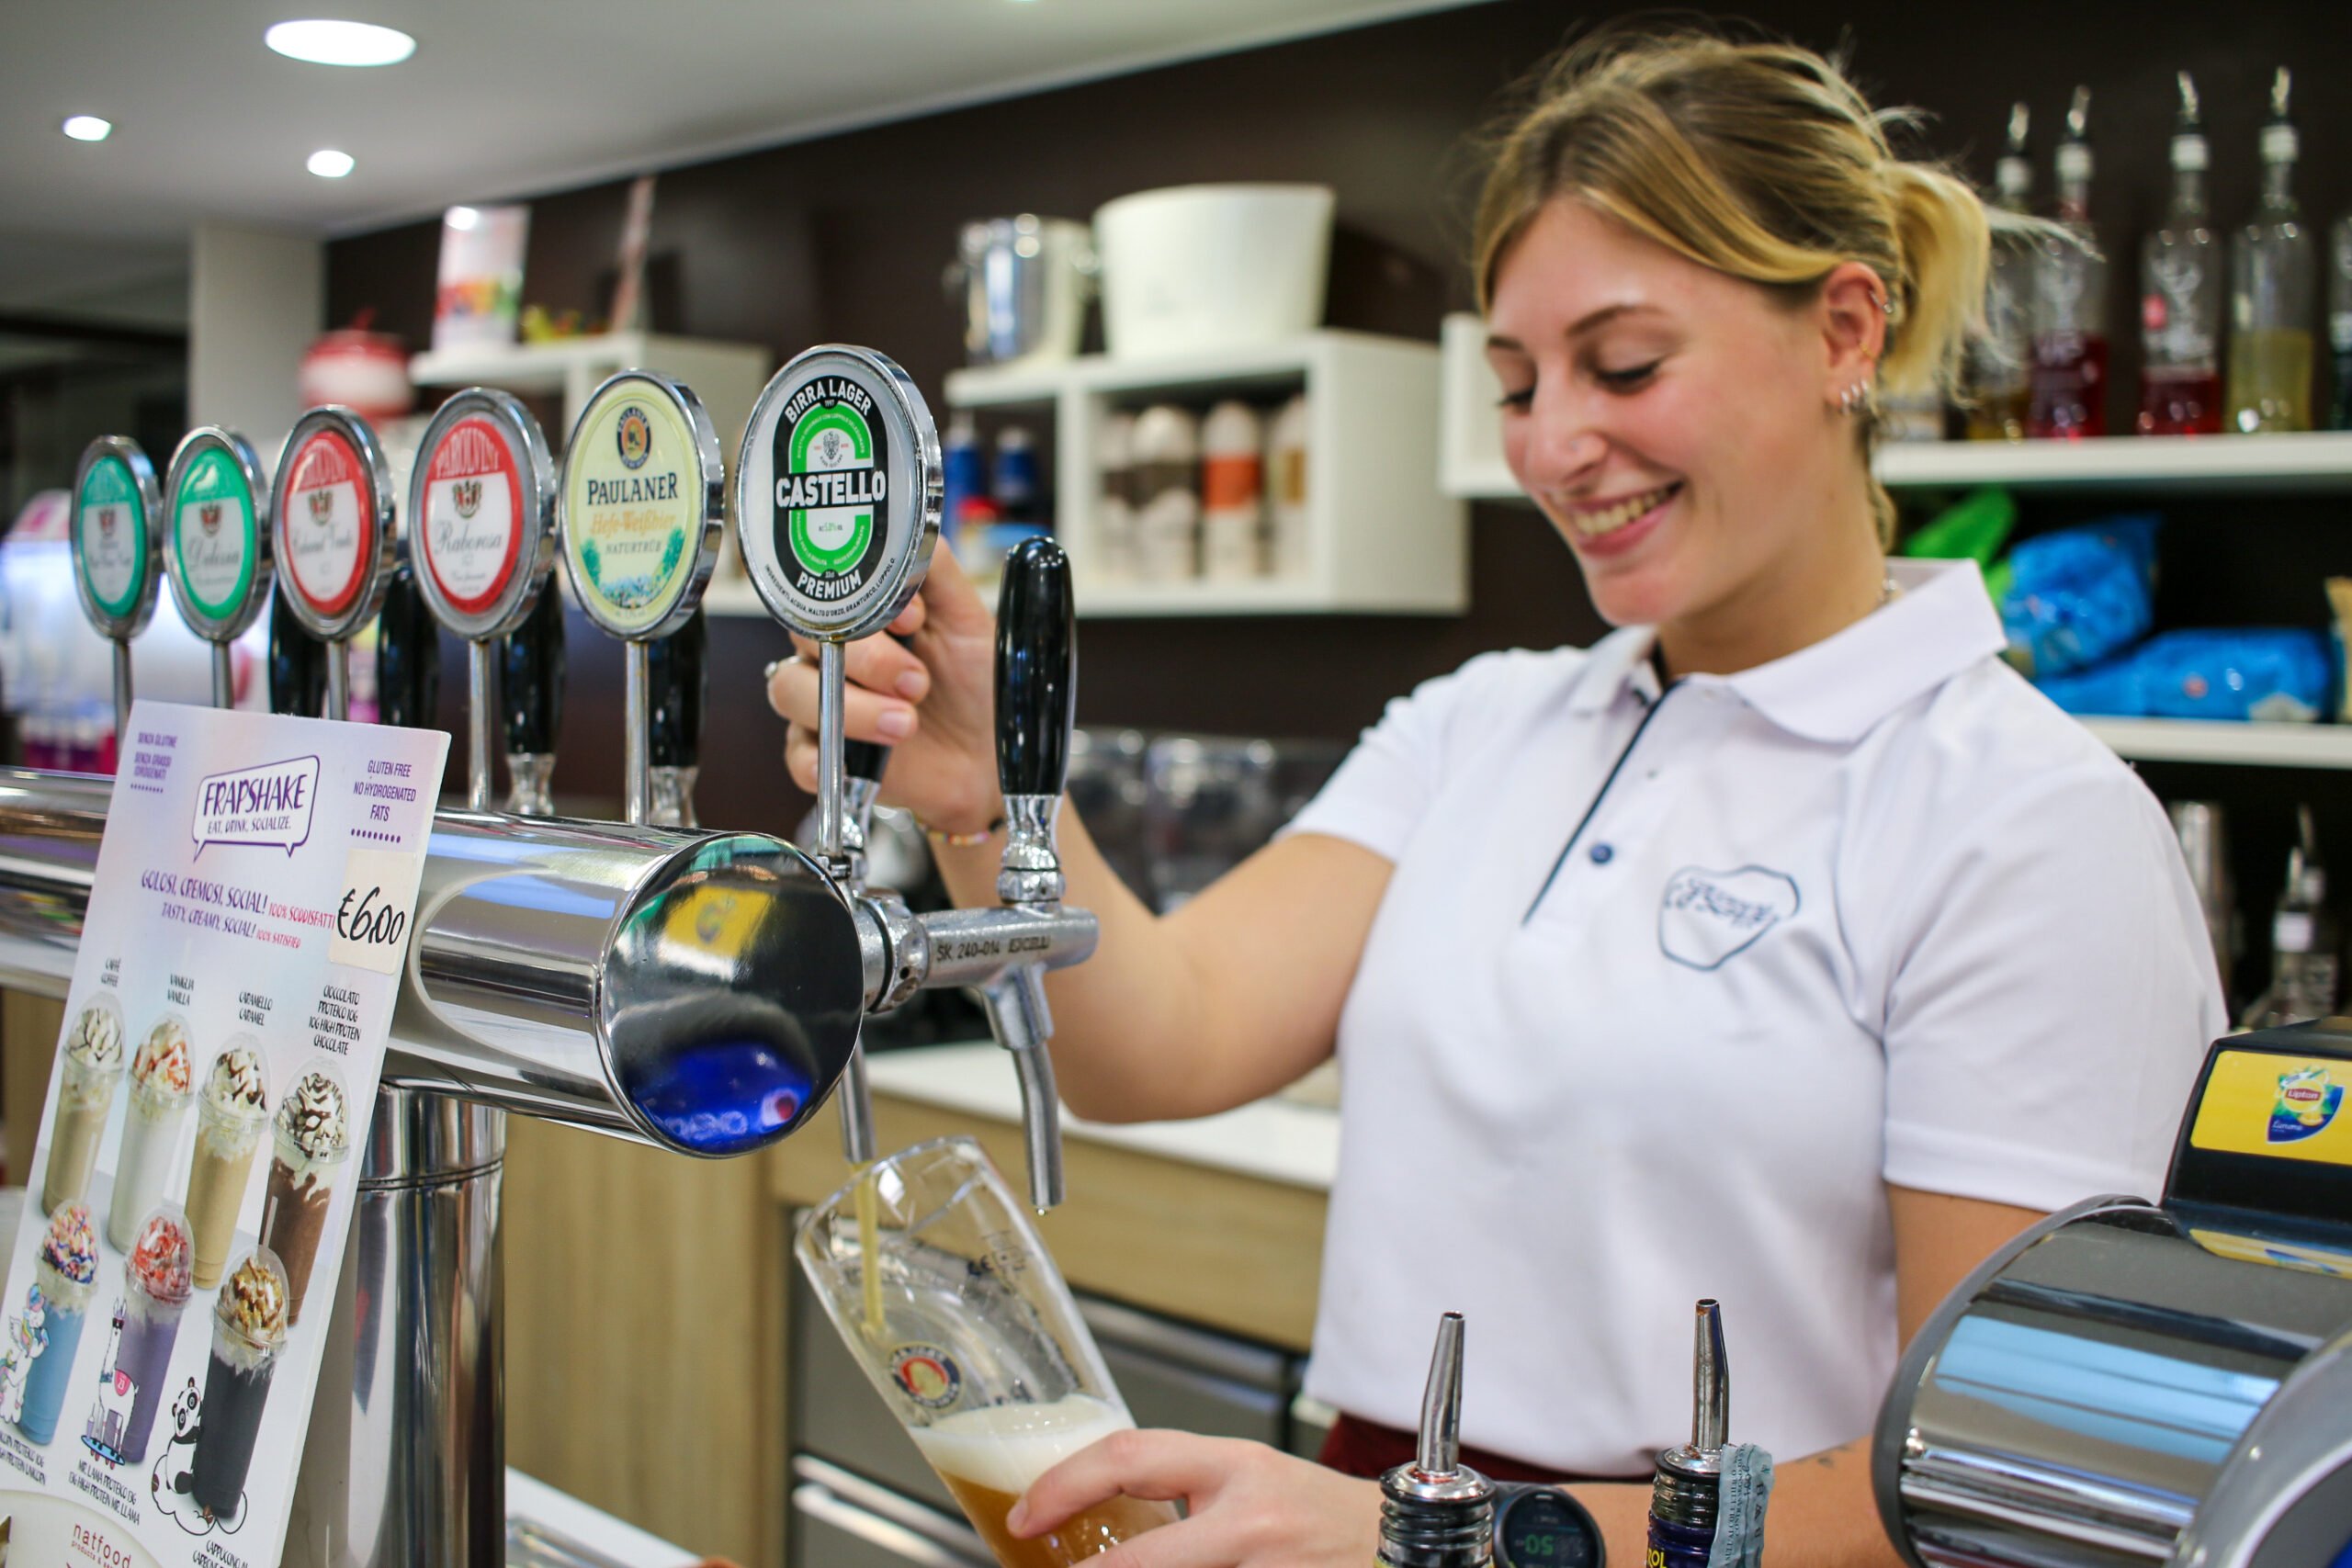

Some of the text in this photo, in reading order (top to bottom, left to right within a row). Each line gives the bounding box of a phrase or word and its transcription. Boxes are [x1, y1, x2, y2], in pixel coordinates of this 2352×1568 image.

[785, 378, 872, 423] BIRRA LAGER
[587, 471, 678, 506] PAULANER
[775, 470, 887, 508] CASTELLO
[797, 569, 863, 600] PREMIUM
[808, 607, 826, 616] MALTO
[368, 760, 412, 778] GLUTEN FREE
[203, 773, 308, 816] FRAPSHAKE
[354, 781, 417, 802] NO HYDROGENATED
[369, 804, 390, 822] FATS
[208, 819, 223, 834] EAT.
[251, 815, 291, 831] SOCIALIZE.
[141, 868, 336, 931] GOLOSI, CREMOSI, SOCIAL! 100% SODDISFATTI
[222, 916, 257, 938] SOCIAL!
[273, 931, 301, 949] SATISFIED
[167, 988, 191, 1006] VANILLA
[239, 991, 273, 1011] CARAMELLO
[323, 984, 360, 1006] CIOCCOLATO
[239, 1007, 265, 1026] CARAMEL
[318, 999, 347, 1020] PROTEICO
[319, 1019, 335, 1034] HIGH
[335, 1022, 362, 1042] PROTEIN
[313, 1033, 349, 1055] CHOCOLATE
[2288, 1089, 2319, 1100] Lipton
[74, 1523, 131, 1568] natfood
